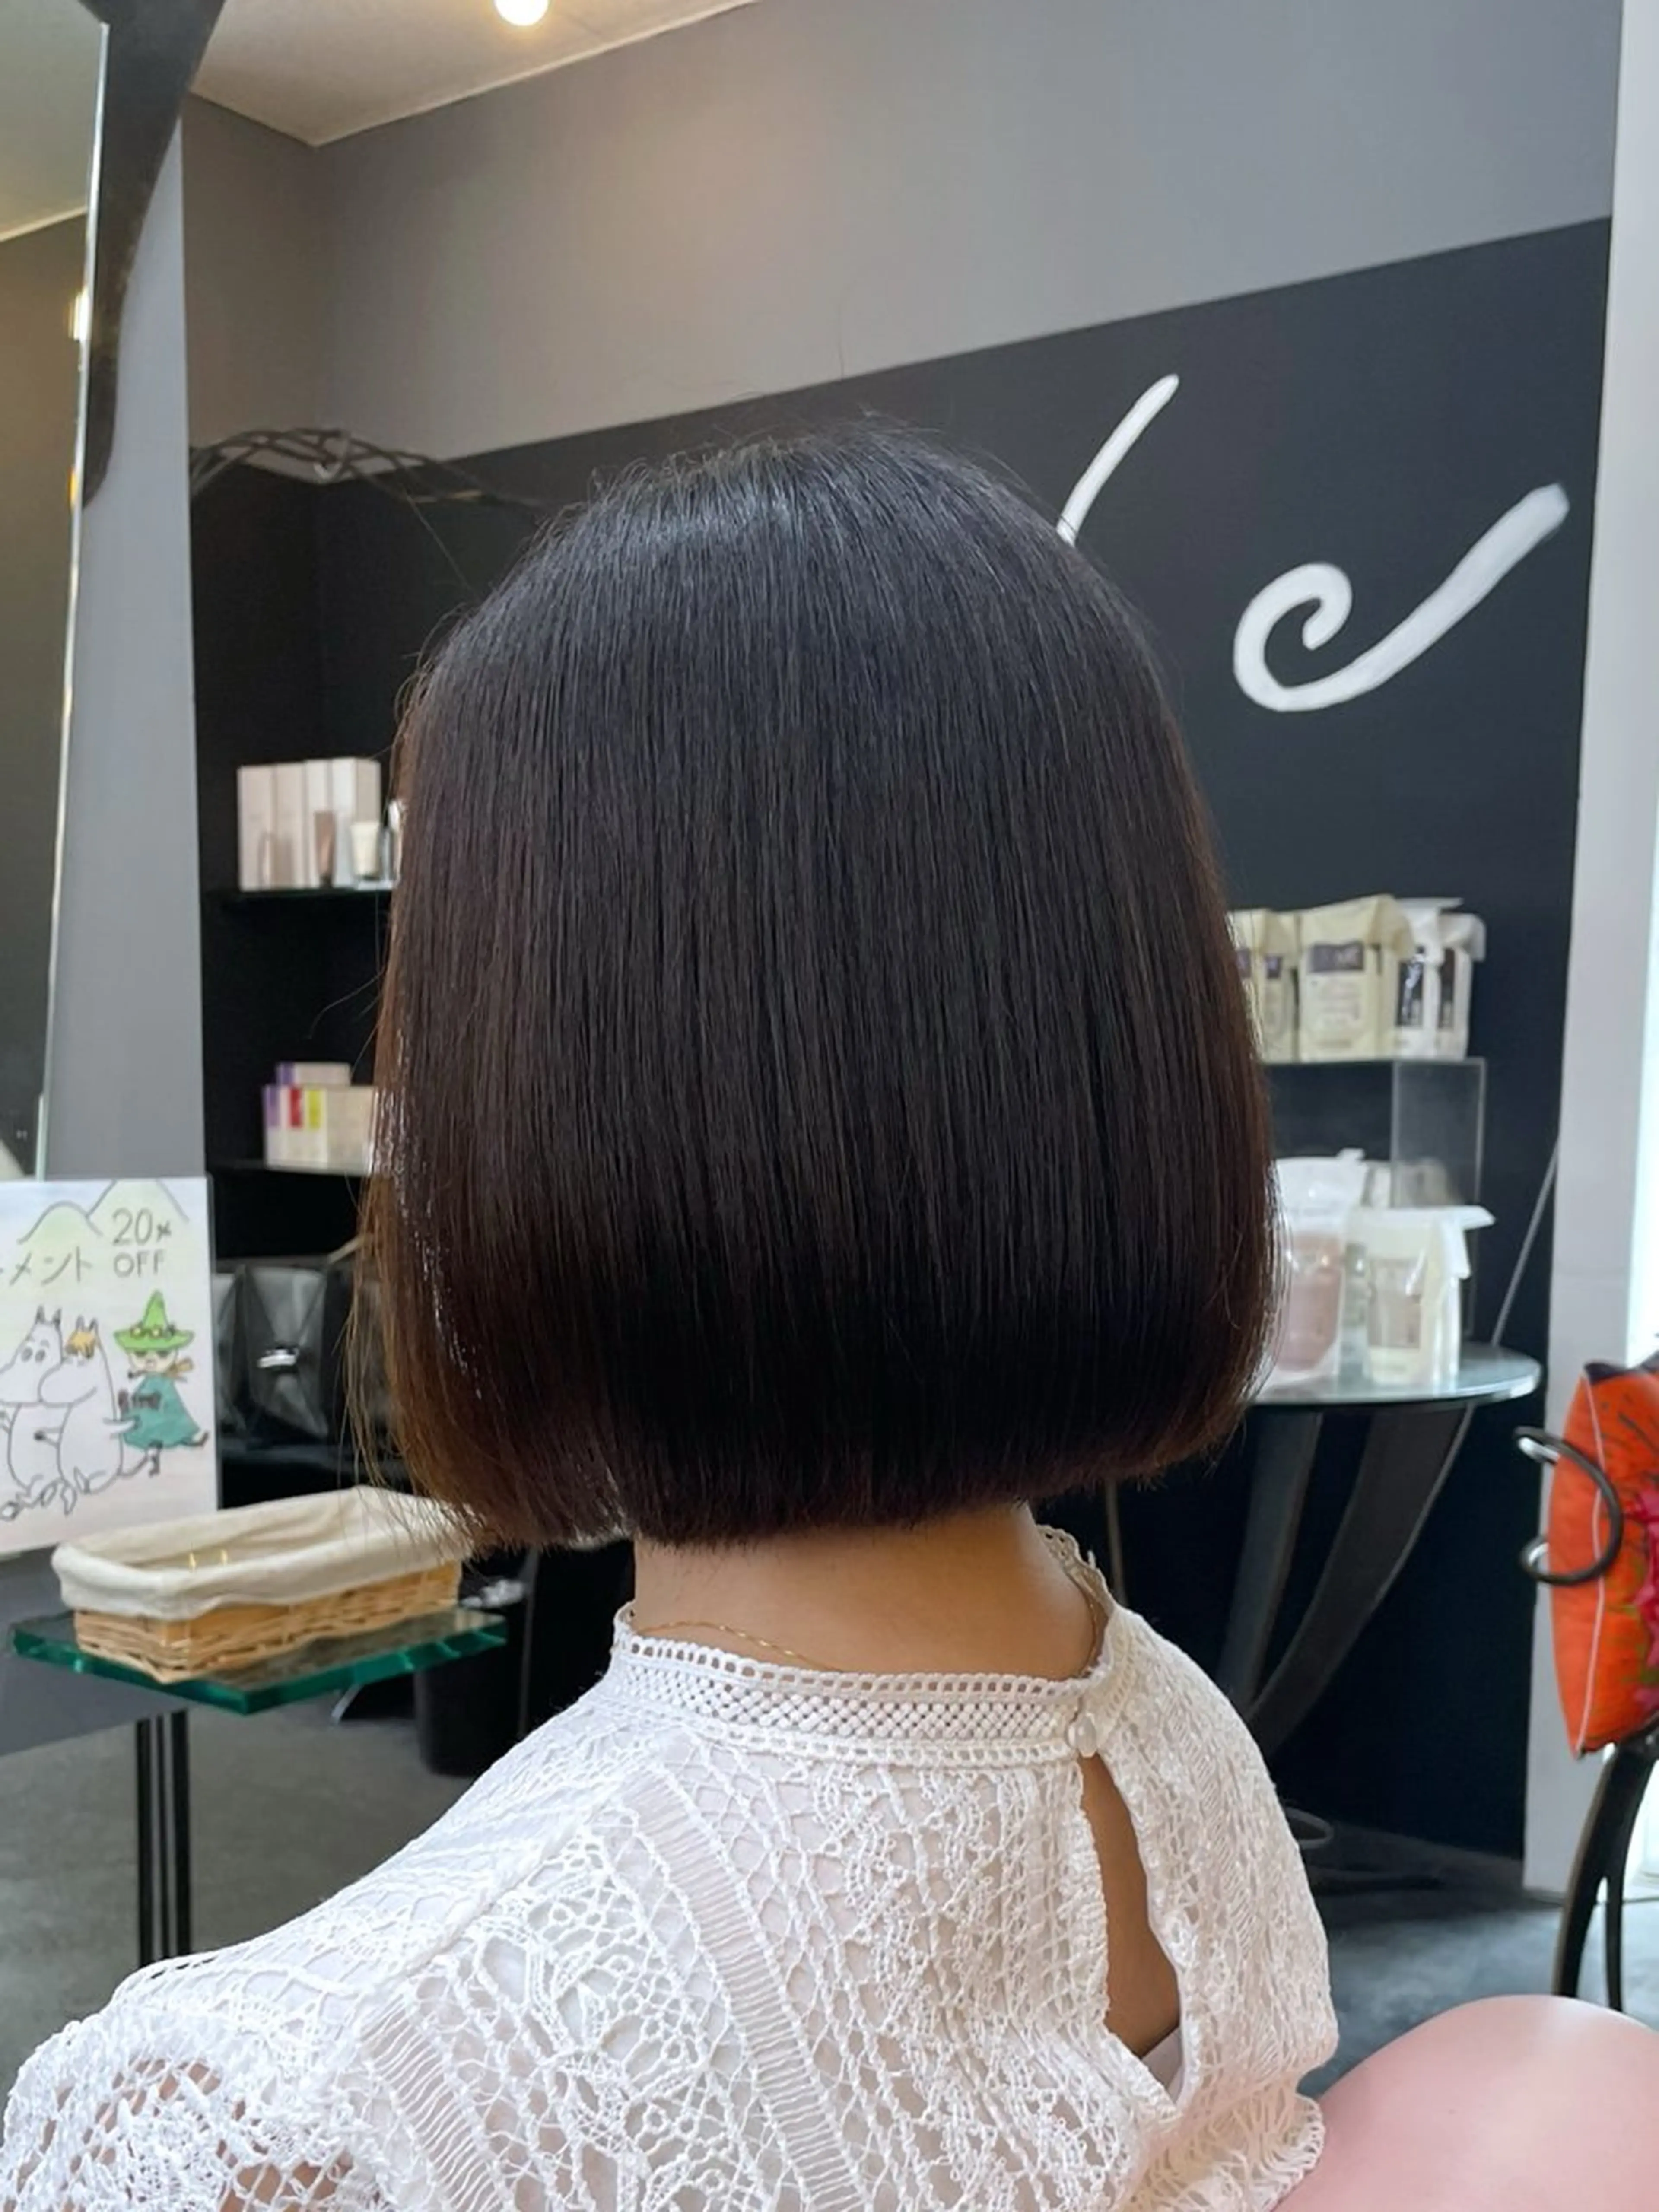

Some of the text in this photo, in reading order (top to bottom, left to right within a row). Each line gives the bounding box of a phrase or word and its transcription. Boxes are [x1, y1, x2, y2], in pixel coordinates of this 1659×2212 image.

[0, 1246, 92, 1286] メント
[113, 1249, 167, 1278] OFF
